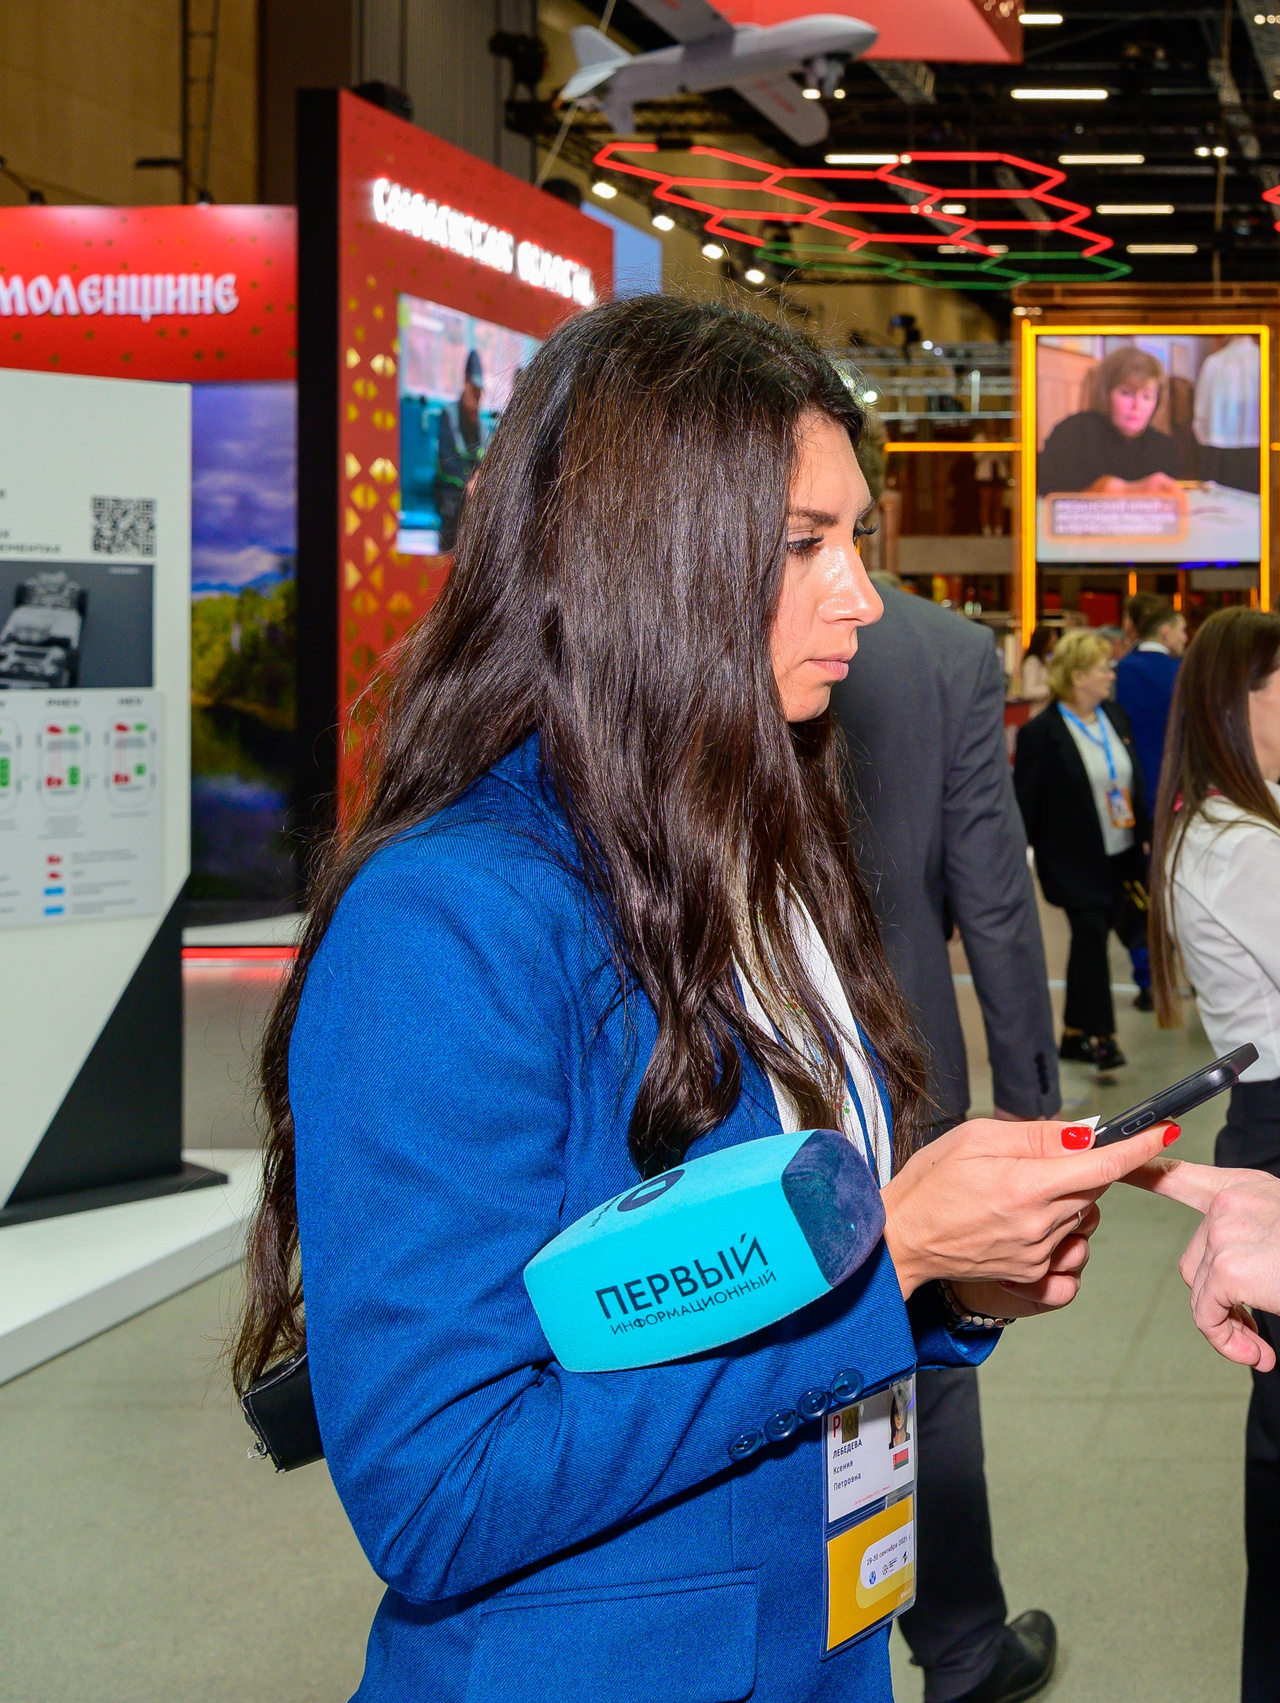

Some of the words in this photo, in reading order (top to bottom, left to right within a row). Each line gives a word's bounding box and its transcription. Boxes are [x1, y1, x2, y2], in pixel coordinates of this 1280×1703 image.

[595, 1233, 769, 1319] ПЕРВЫЙ
[610, 1269, 778, 1335] ИНФОРМАЦИОННЫЙ
[833, 1439, 863, 1459] ЛЕБЕДЕВА
[833, 1460, 854, 1475] Ксения
[833, 1472, 862, 1491] Петровна
